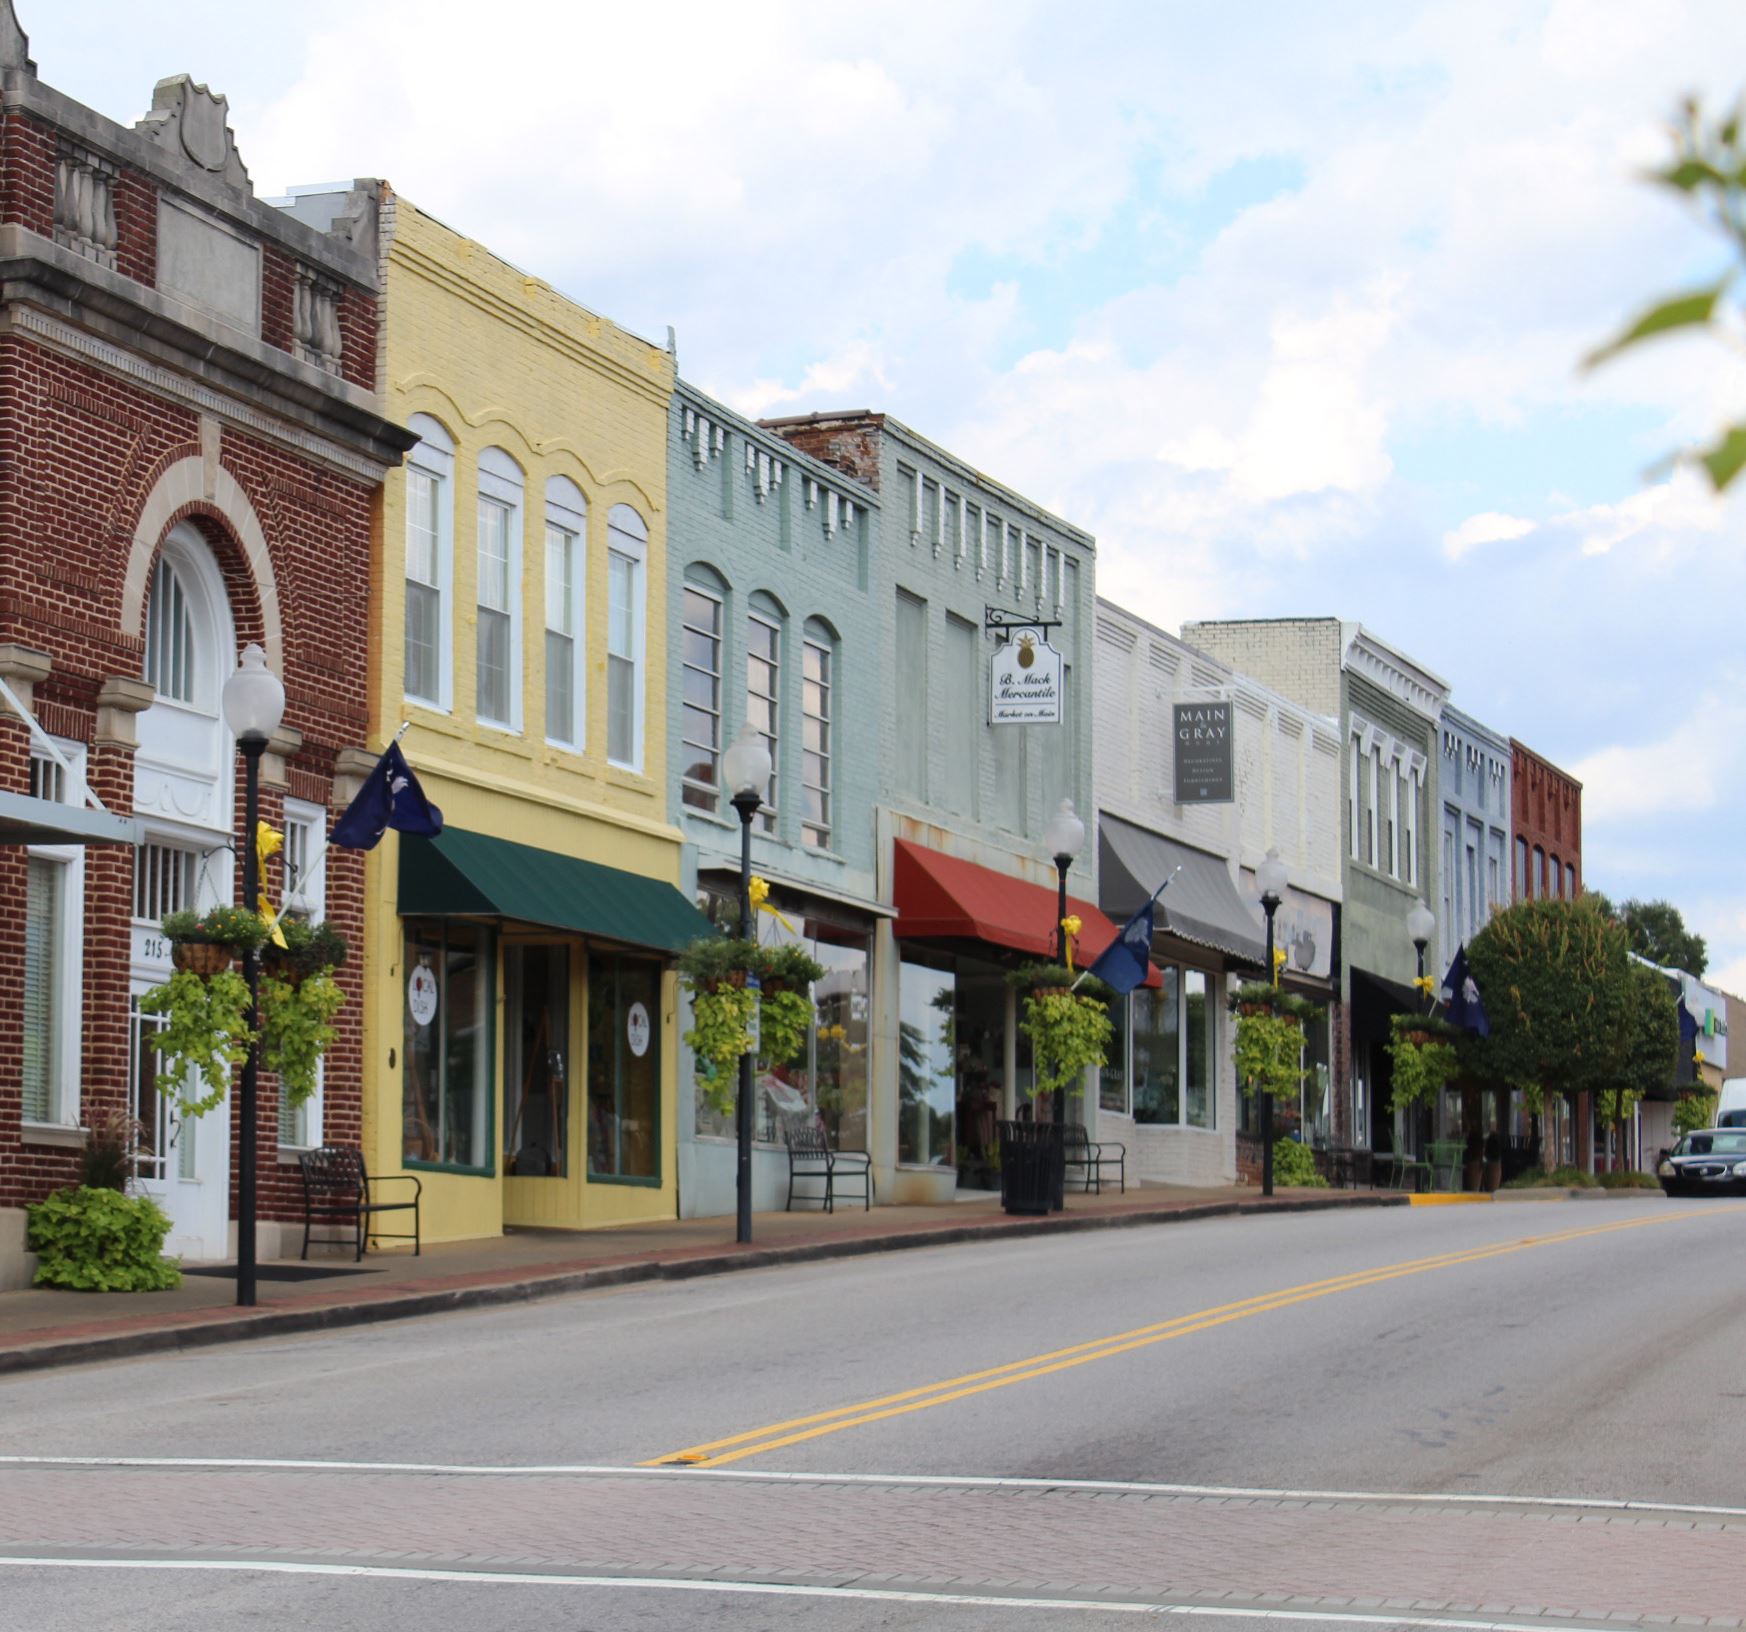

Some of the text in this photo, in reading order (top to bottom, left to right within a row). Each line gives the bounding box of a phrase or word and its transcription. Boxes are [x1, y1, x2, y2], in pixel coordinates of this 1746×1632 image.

[1000, 672, 1050, 685] B. Mack
[995, 686, 1056, 699] Mercantile
[1180, 708, 1225, 722] MAIN
[1179, 726, 1226, 740] GRAY
[145, 939, 162, 958] 215
